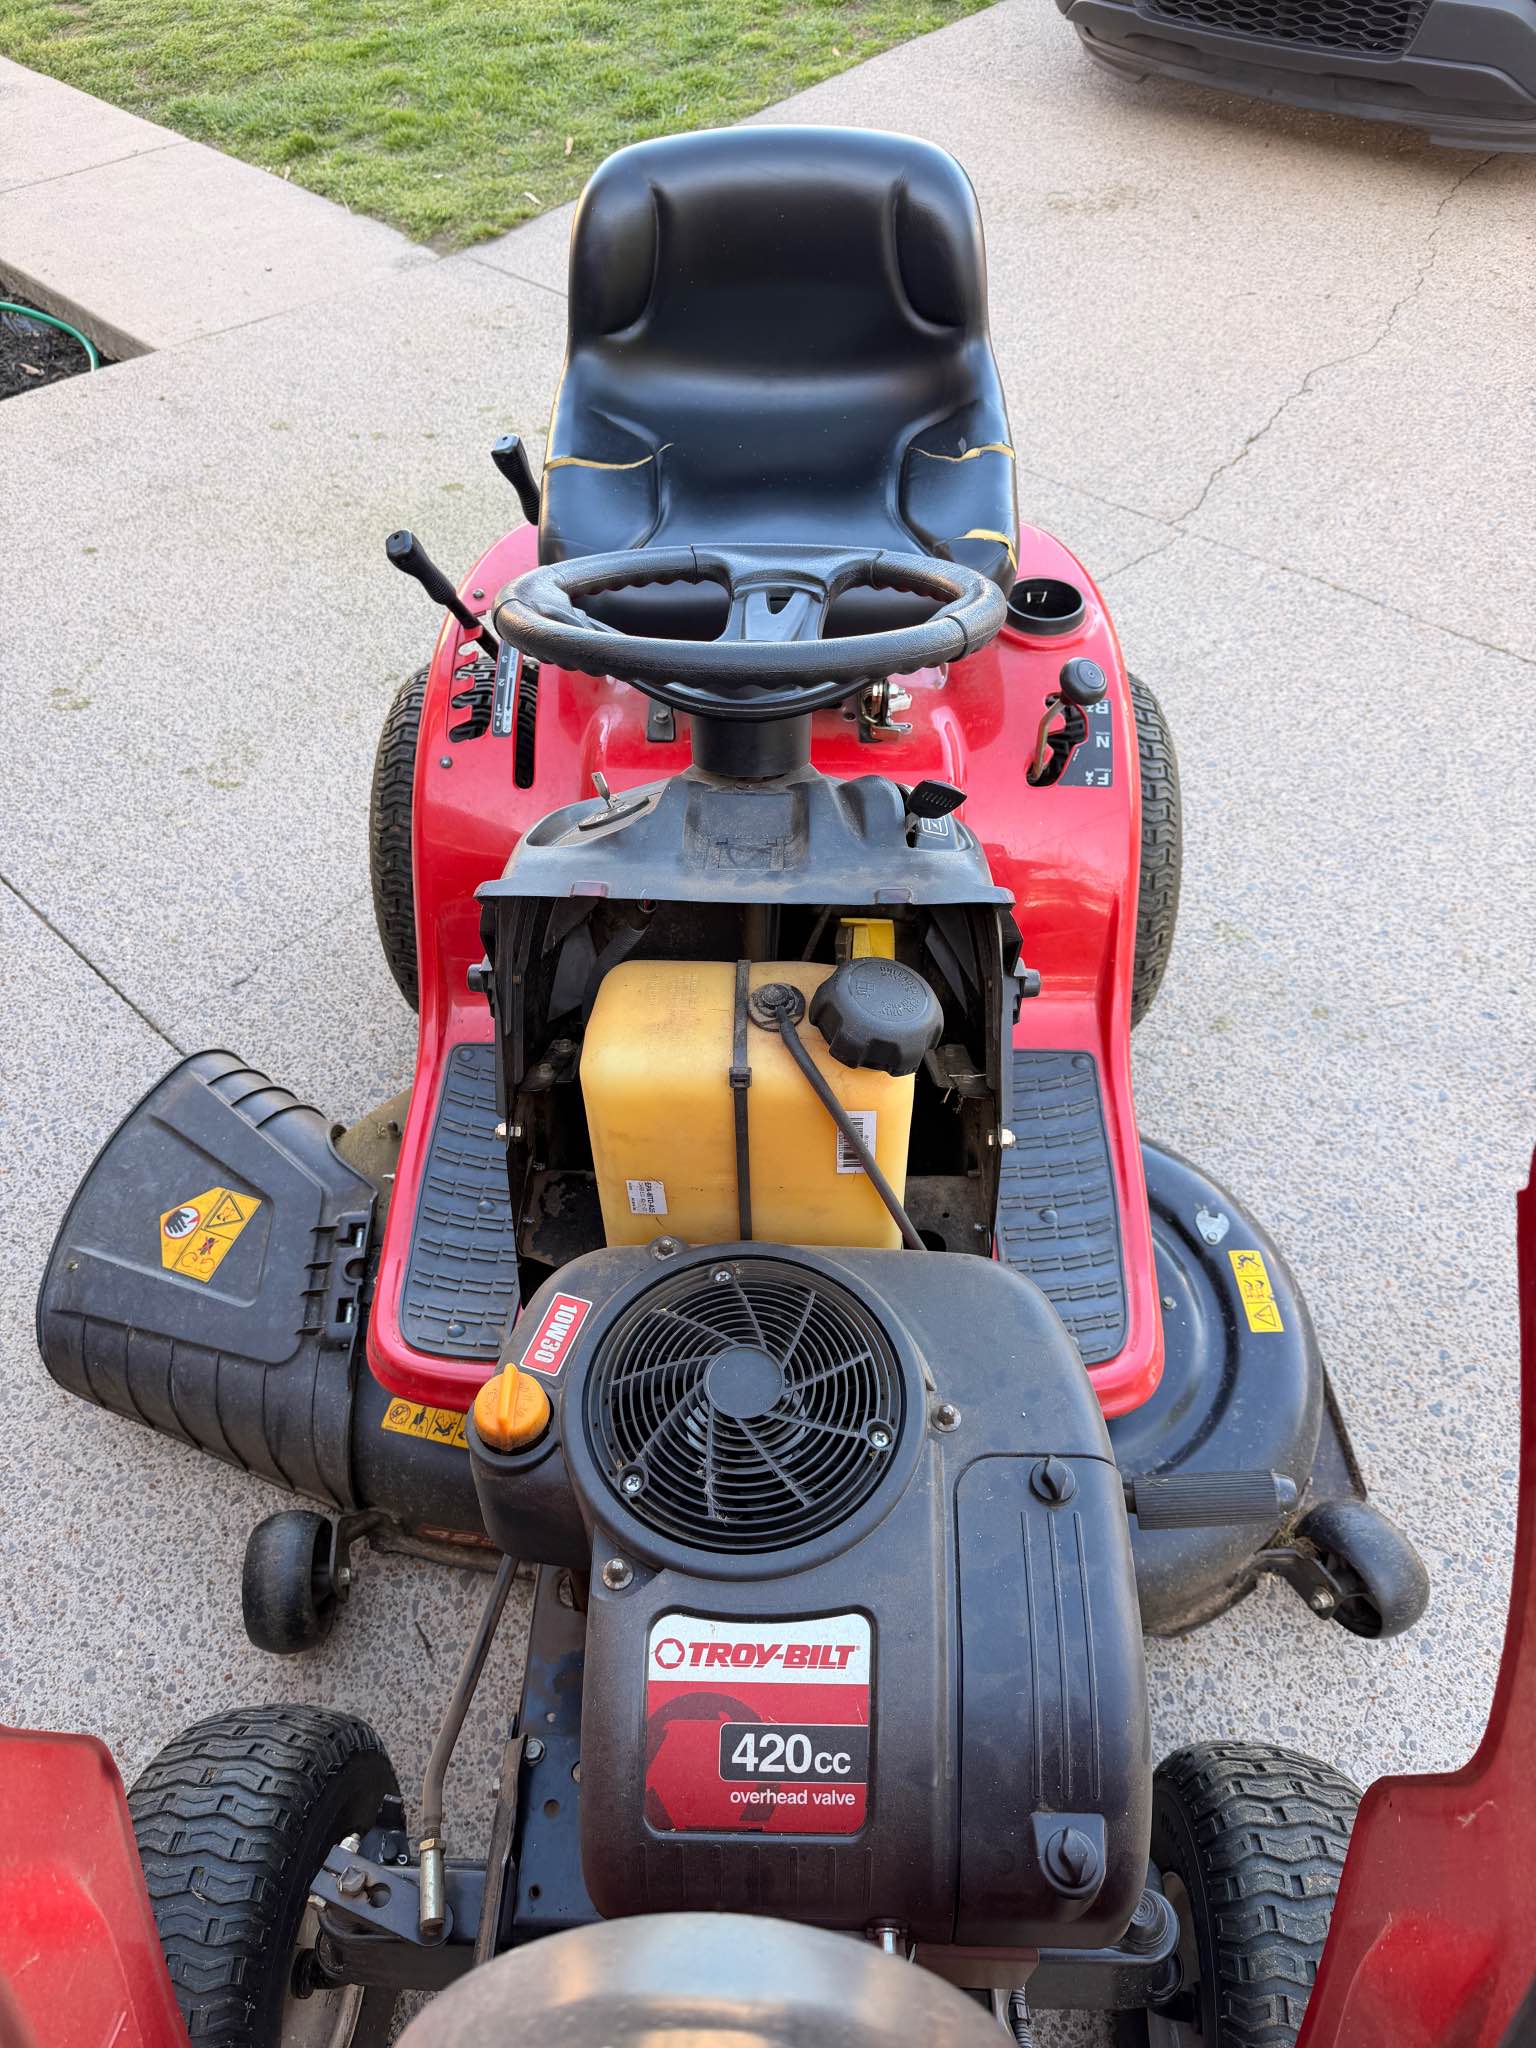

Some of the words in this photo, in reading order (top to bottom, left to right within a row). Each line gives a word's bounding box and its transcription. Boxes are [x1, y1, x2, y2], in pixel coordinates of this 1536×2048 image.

[1096, 735, 1110, 748] N
[1097, 772, 1109, 786] F
[534, 1304, 578, 1364] 10W30
[688, 1642, 856, 1670] TROY-BILT
[731, 1733, 851, 1774] 420cc
[730, 1789, 808, 1805] overhead
[813, 1790, 856, 1806] valve
